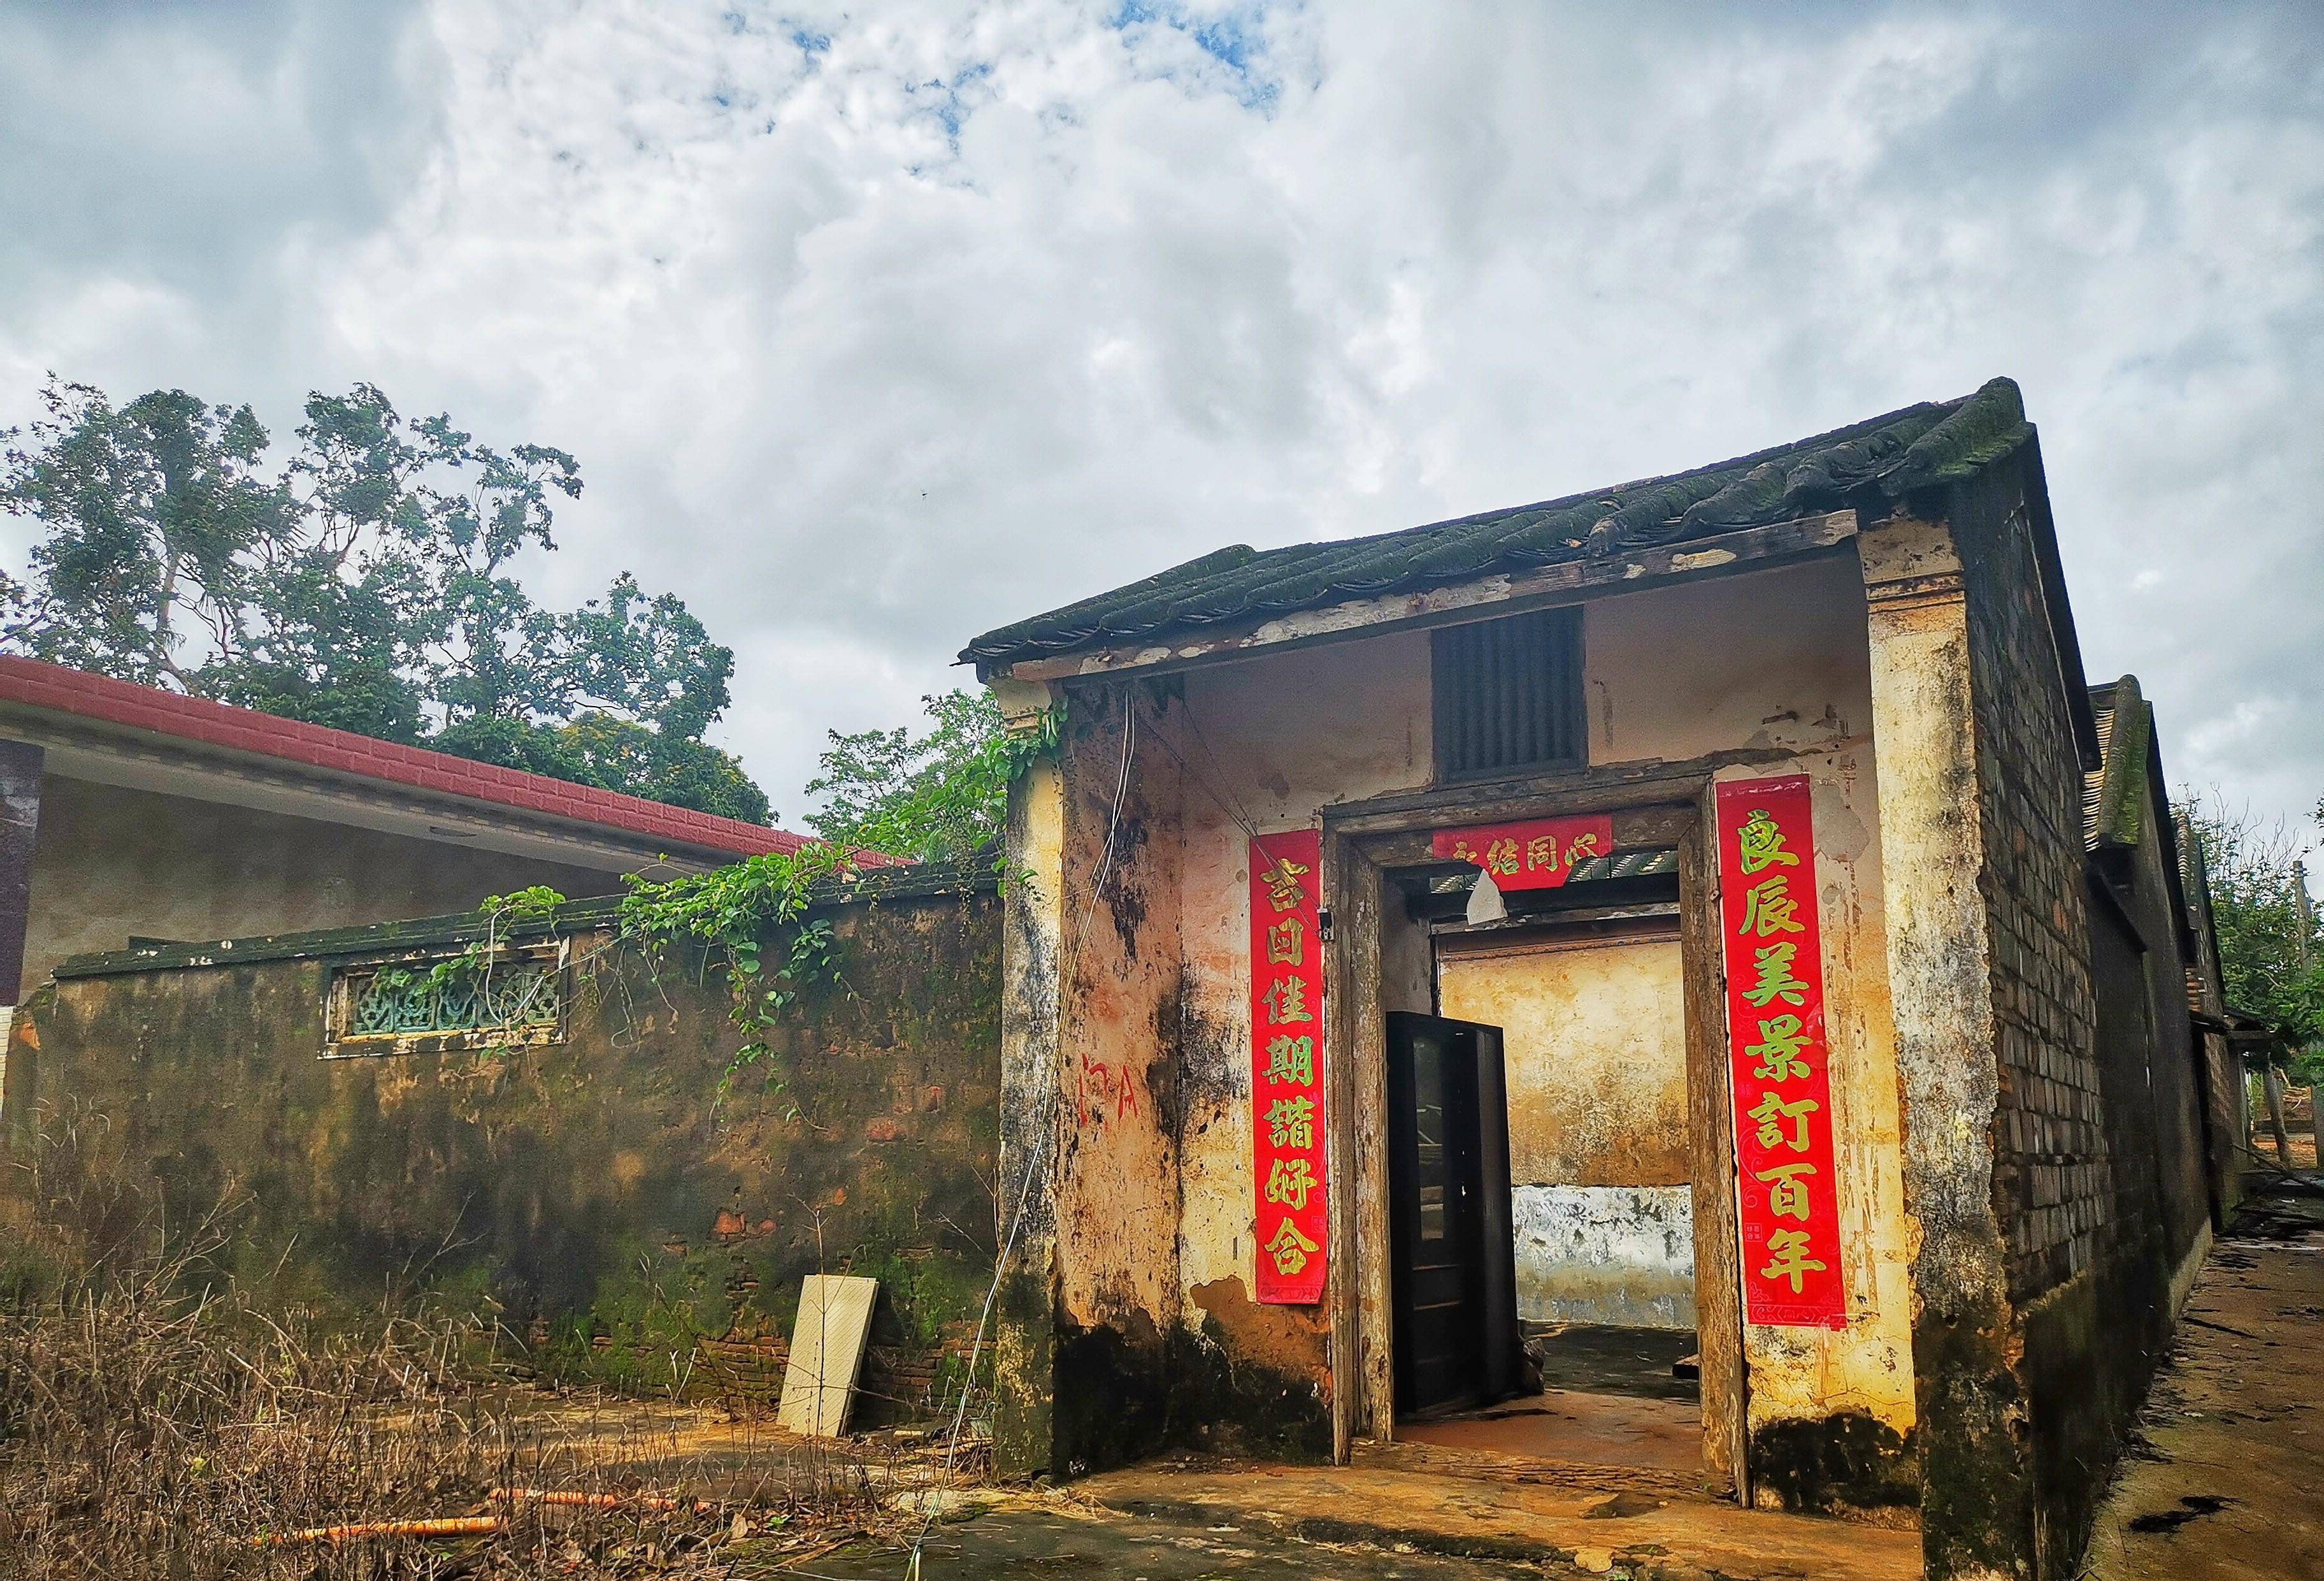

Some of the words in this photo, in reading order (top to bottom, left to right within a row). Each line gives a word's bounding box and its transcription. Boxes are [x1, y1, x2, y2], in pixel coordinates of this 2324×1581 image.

[1259, 858, 1319, 1275] 吉日佳期諧好合
[1738, 810, 1827, 1294] 良辰美景訂百年
